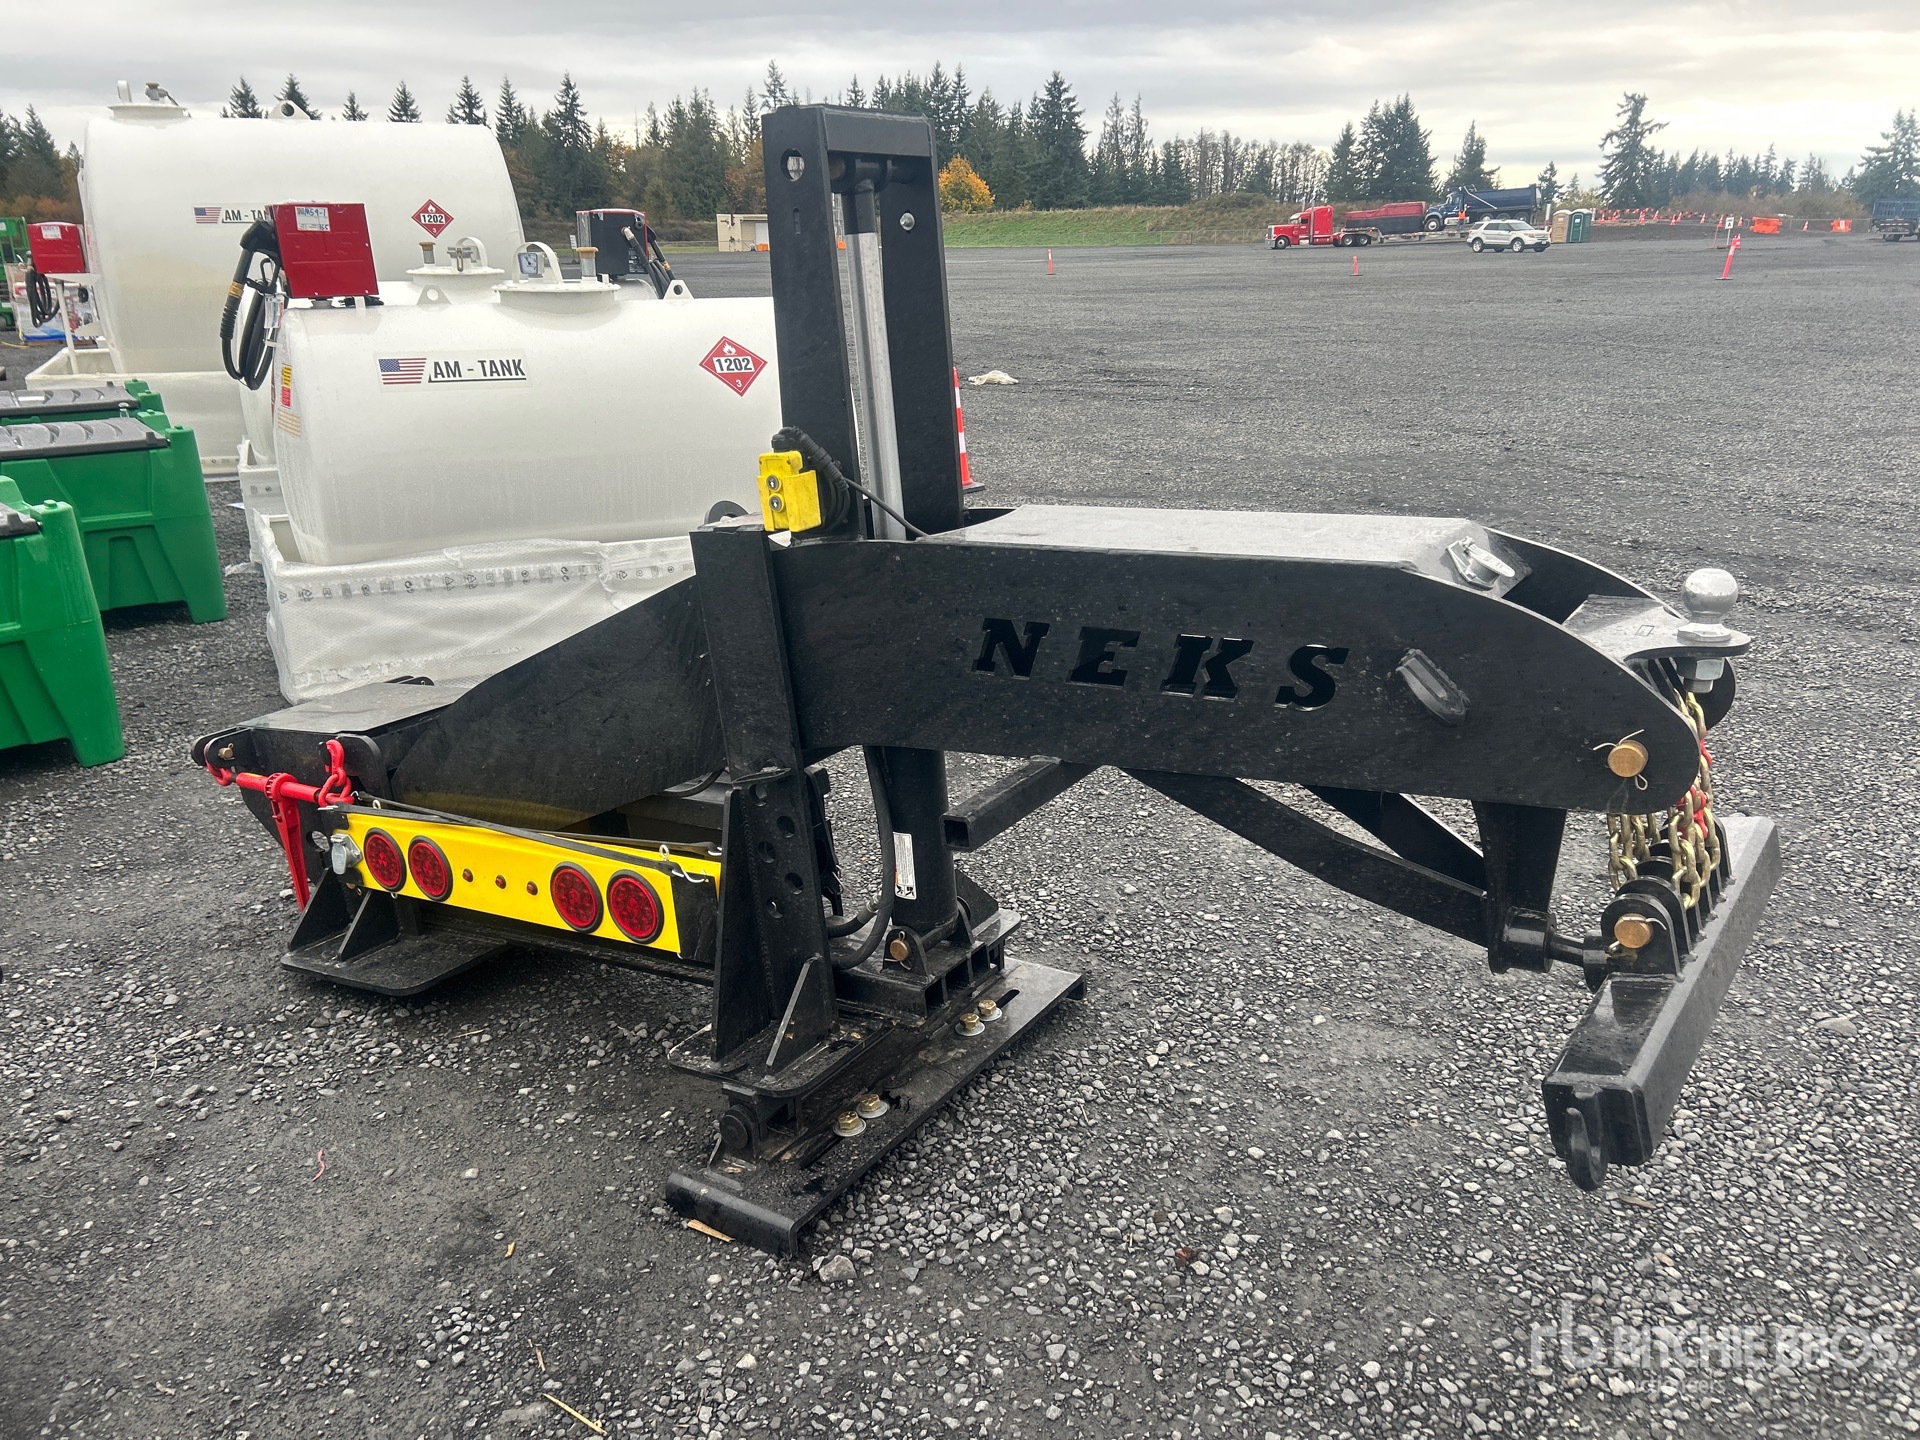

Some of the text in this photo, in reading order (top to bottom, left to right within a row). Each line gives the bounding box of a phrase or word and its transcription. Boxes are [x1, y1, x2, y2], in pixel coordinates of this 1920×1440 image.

[225, 210, 242, 221] AM
[421, 214, 444, 224] 1202
[433, 361, 462, 379] AM
[477, 359, 526, 378] TANK
[715, 357, 753, 372] 1202
[735, 379, 742, 388] 3
[970, 618, 1350, 711] NEKS
